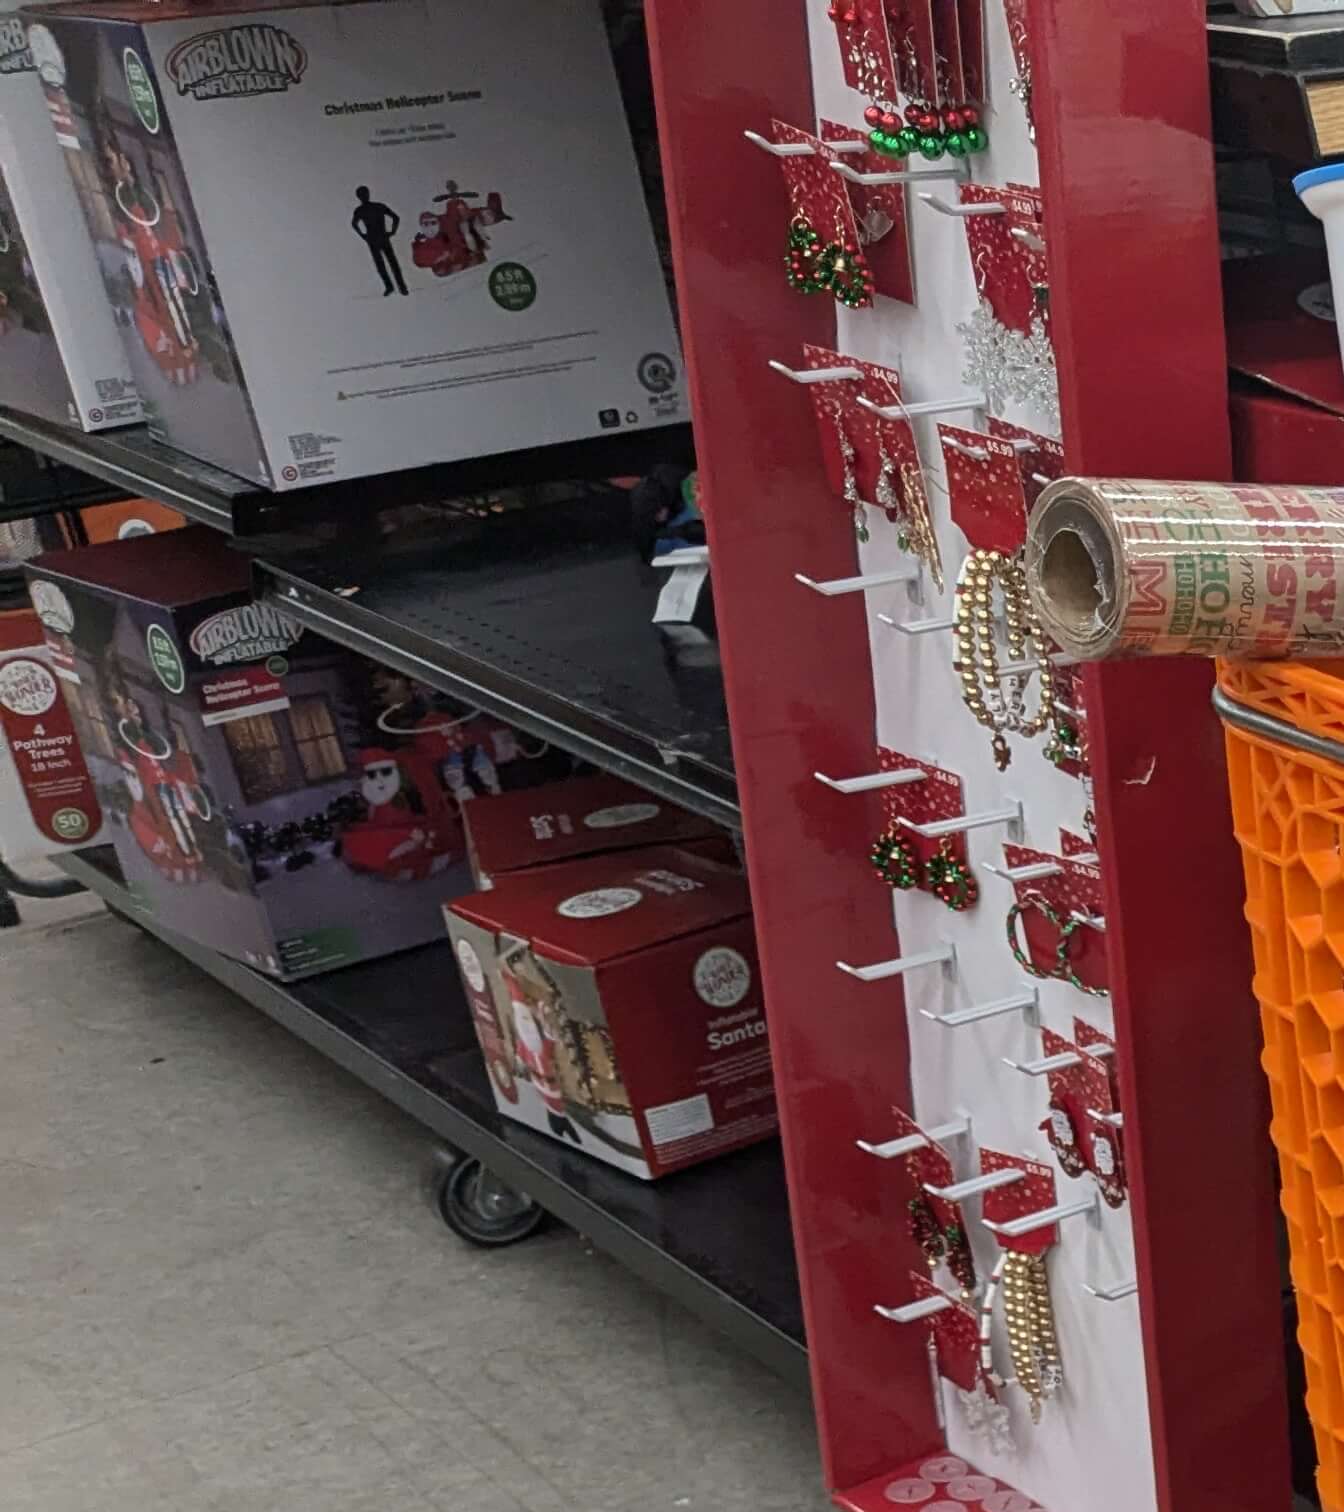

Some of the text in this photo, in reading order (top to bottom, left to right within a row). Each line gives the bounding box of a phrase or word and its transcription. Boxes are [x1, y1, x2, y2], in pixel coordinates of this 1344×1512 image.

[175, 26, 299, 96] AIRBLOWN
[190, 74, 289, 99] INFLATABLE
[34, 722, 47, 737] 4
[13, 733, 73, 752] Pathway
[28, 747, 66, 761] Trees
[57, 813, 82, 828] 50
[706, 1020, 767, 1051] Santa
